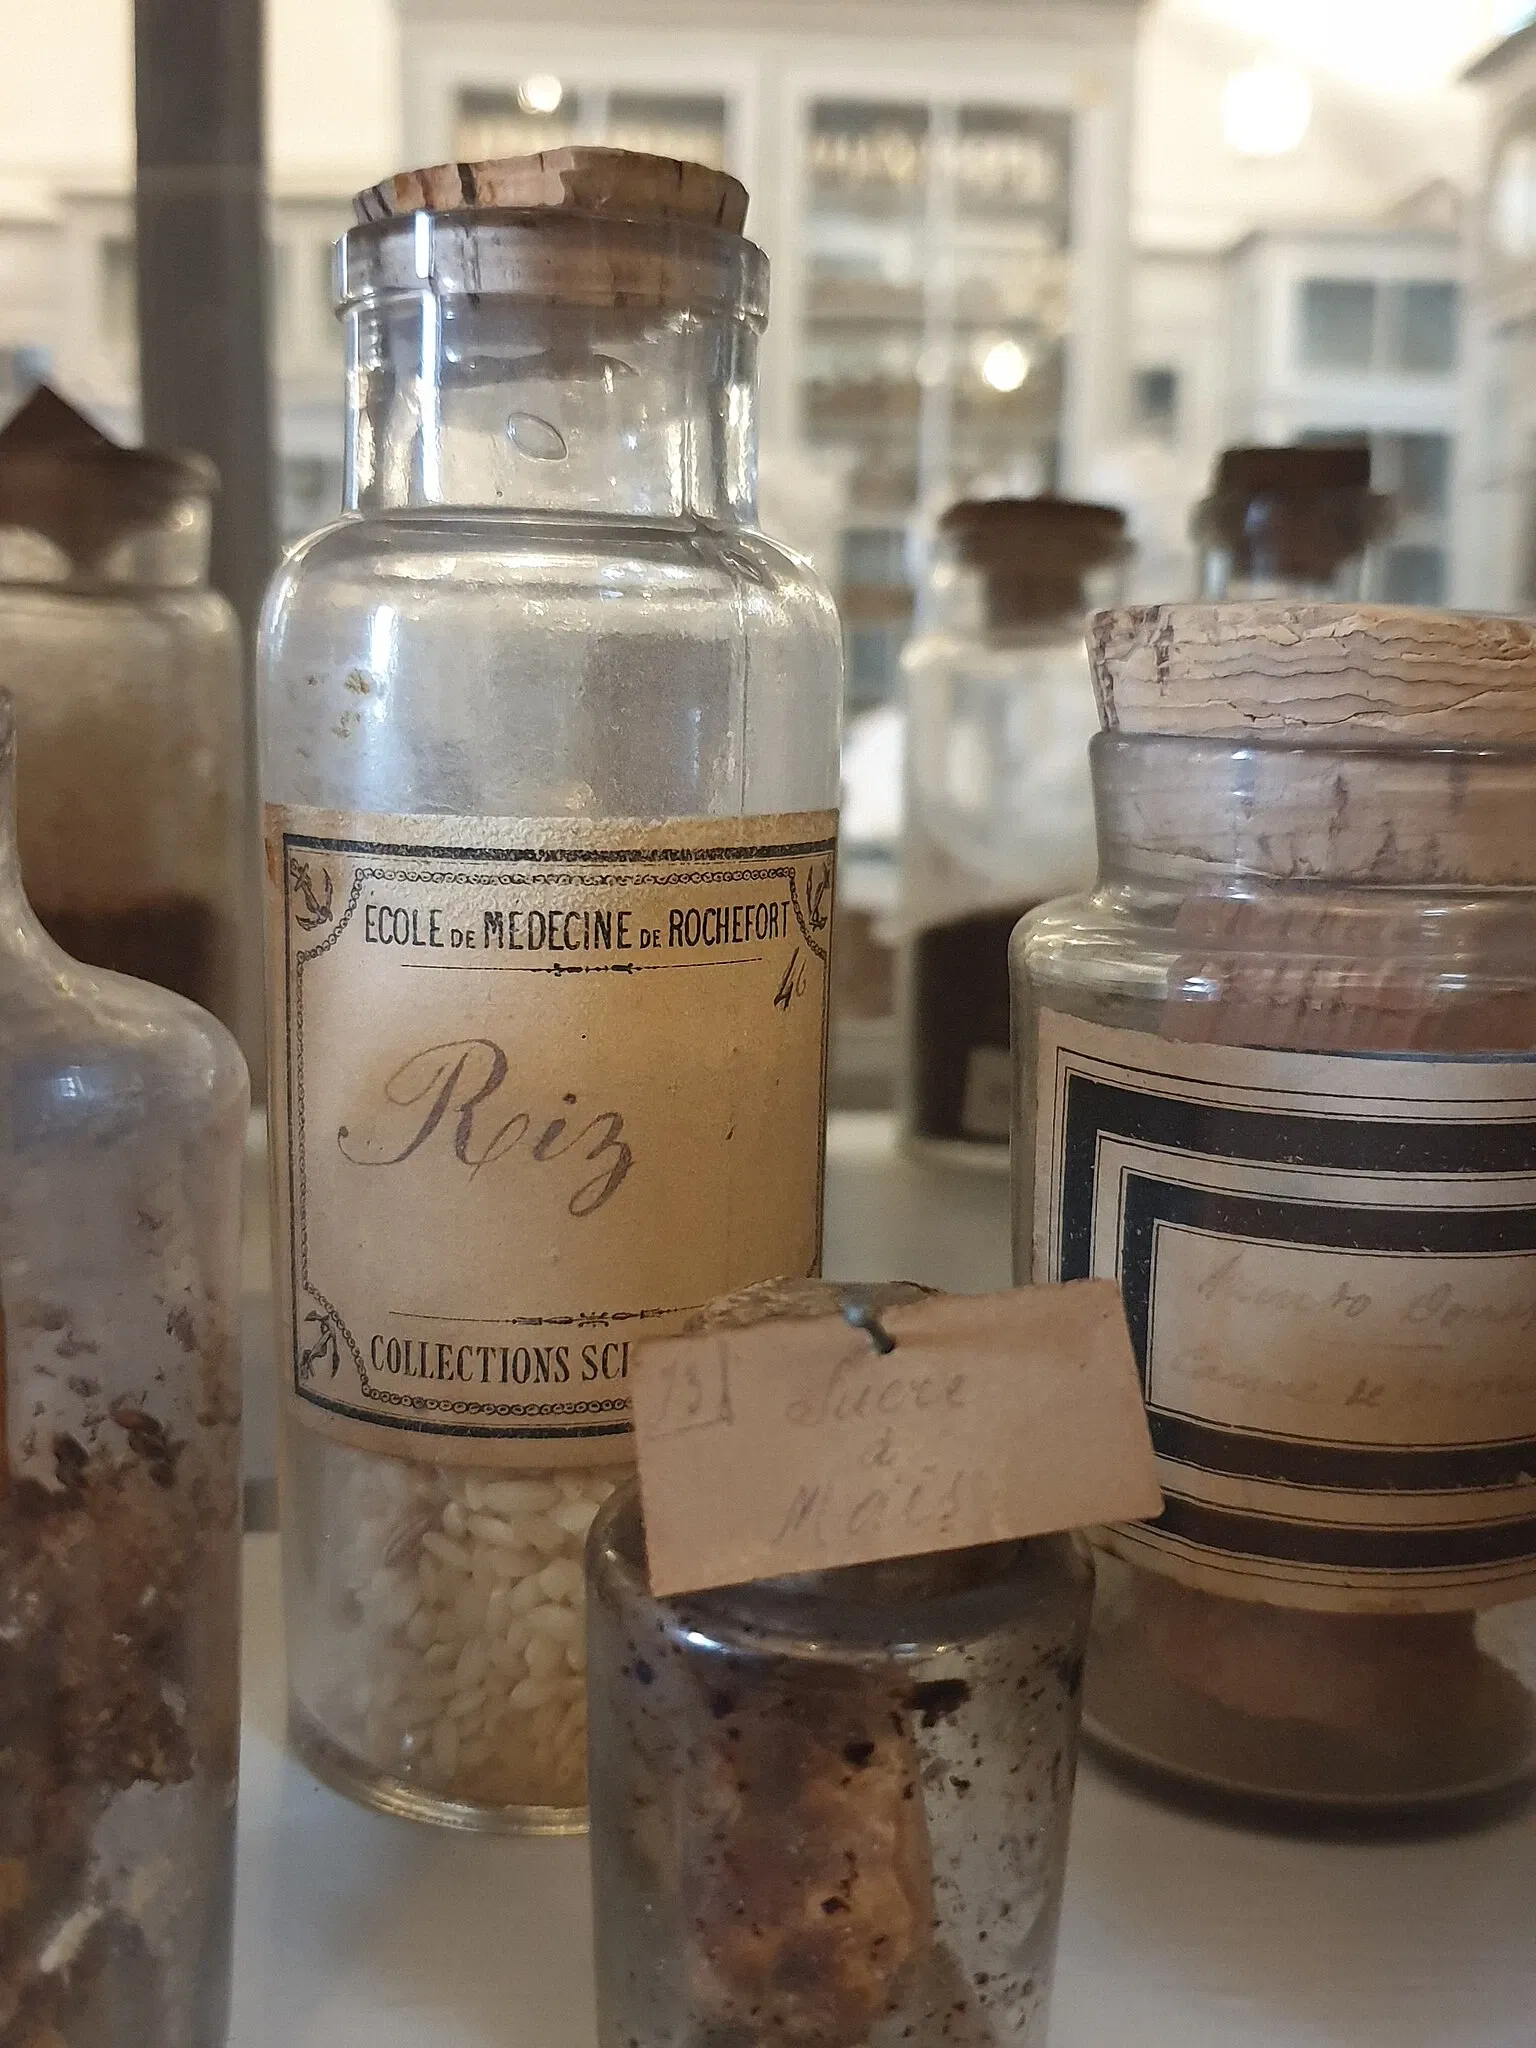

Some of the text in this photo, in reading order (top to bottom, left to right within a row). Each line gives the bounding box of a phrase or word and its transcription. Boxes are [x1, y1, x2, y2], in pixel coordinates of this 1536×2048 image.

[450, 927, 476, 949] DE
[639, 927, 662, 949] DE
[668, 900, 791, 948] ROCHEFORT
[337, 1037, 637, 1218] Riz
[370, 1333, 570, 1385] COLLECTIONS
